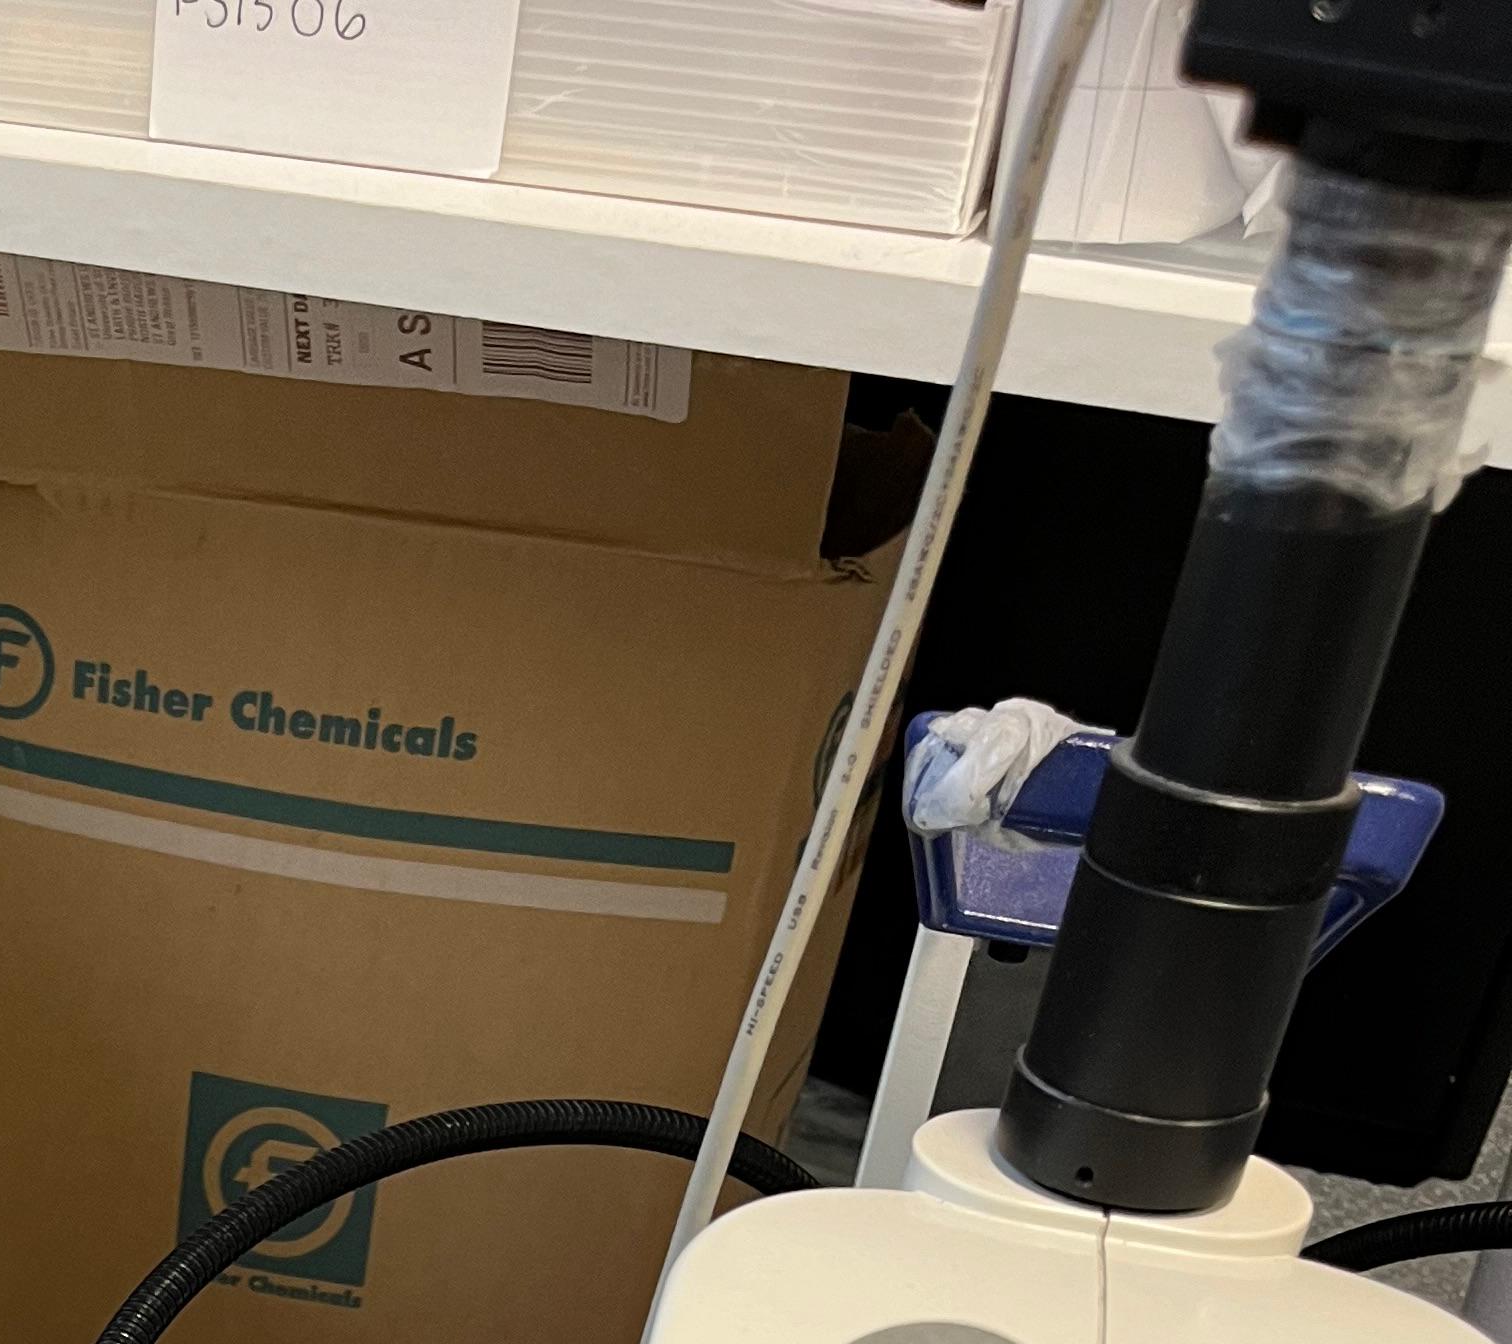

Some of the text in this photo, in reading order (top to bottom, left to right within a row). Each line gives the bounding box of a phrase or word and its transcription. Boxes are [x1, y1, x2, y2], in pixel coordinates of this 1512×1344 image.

[294, 319, 313, 364] NEXT
[323, 322, 343, 366] TRK#
[398, 314, 433, 372] A S
[73, 661, 478, 762] Fisher Chemicals
[746, 952, 784, 1036] HI-SPEED
[787, 894, 808, 930] USB
[841, 753, 858, 784] 2.0
[860, 629, 902, 730] SHIELDED
